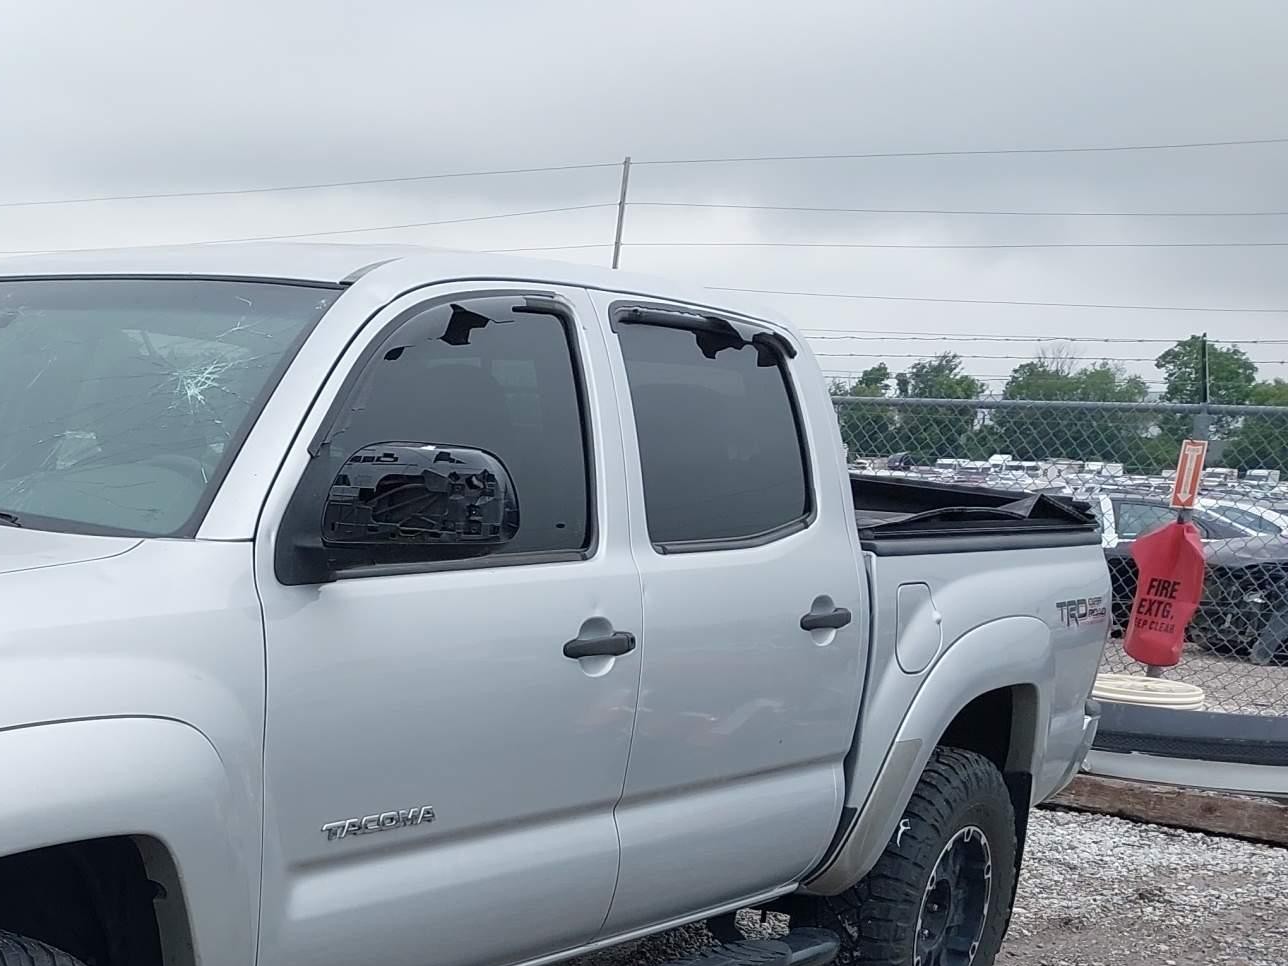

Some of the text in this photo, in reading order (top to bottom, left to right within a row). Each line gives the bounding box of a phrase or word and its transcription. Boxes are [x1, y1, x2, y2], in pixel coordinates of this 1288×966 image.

[1146, 577, 1181, 599] FIRE
[1056, 598, 1088, 627] TRD
[321, 804, 437, 842] TACOMA
